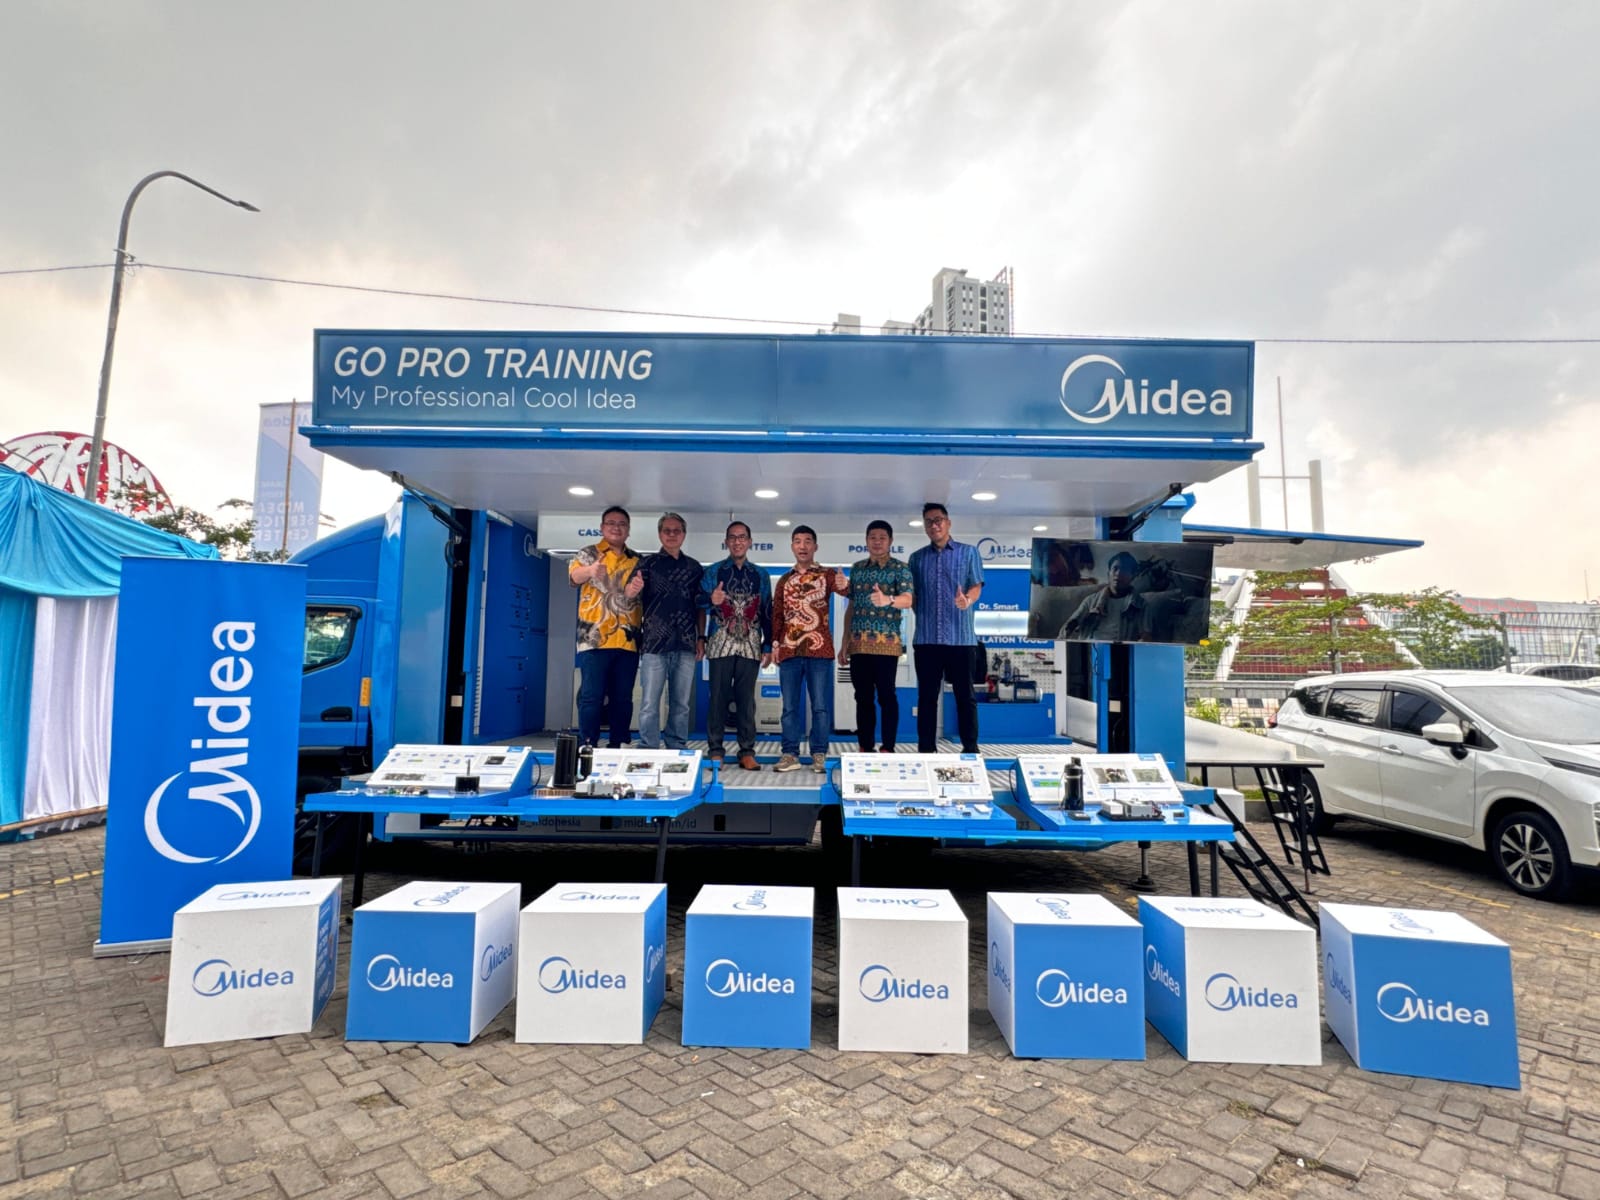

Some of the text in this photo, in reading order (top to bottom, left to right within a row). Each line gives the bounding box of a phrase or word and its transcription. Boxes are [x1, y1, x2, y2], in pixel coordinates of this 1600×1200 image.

[334, 346, 653, 381] GO PRO TRAINING
[331, 385, 637, 409] My Professional Cool Idea
[1059, 378, 1232, 424] Midea
[578, 529, 604, 537] CASS
[721, 543, 774, 551] ITER
[848, 545, 905, 553] PORLE
[188, 621, 261, 865] Midea
[559, 891, 640, 901] Midea
[480, 944, 512, 982] Midea
[1146, 944, 1181, 998] Midea
[192, 967, 294, 997] Midea
[367, 967, 453, 992] Midea
[538, 969, 626, 994] Midea
[705, 972, 795, 998] Midea
[859, 978, 949, 1003] Midea
[1036, 982, 1128, 1008] Midea
[1205, 986, 1298, 1011] Midea
[1376, 996, 1490, 1026] Midea
